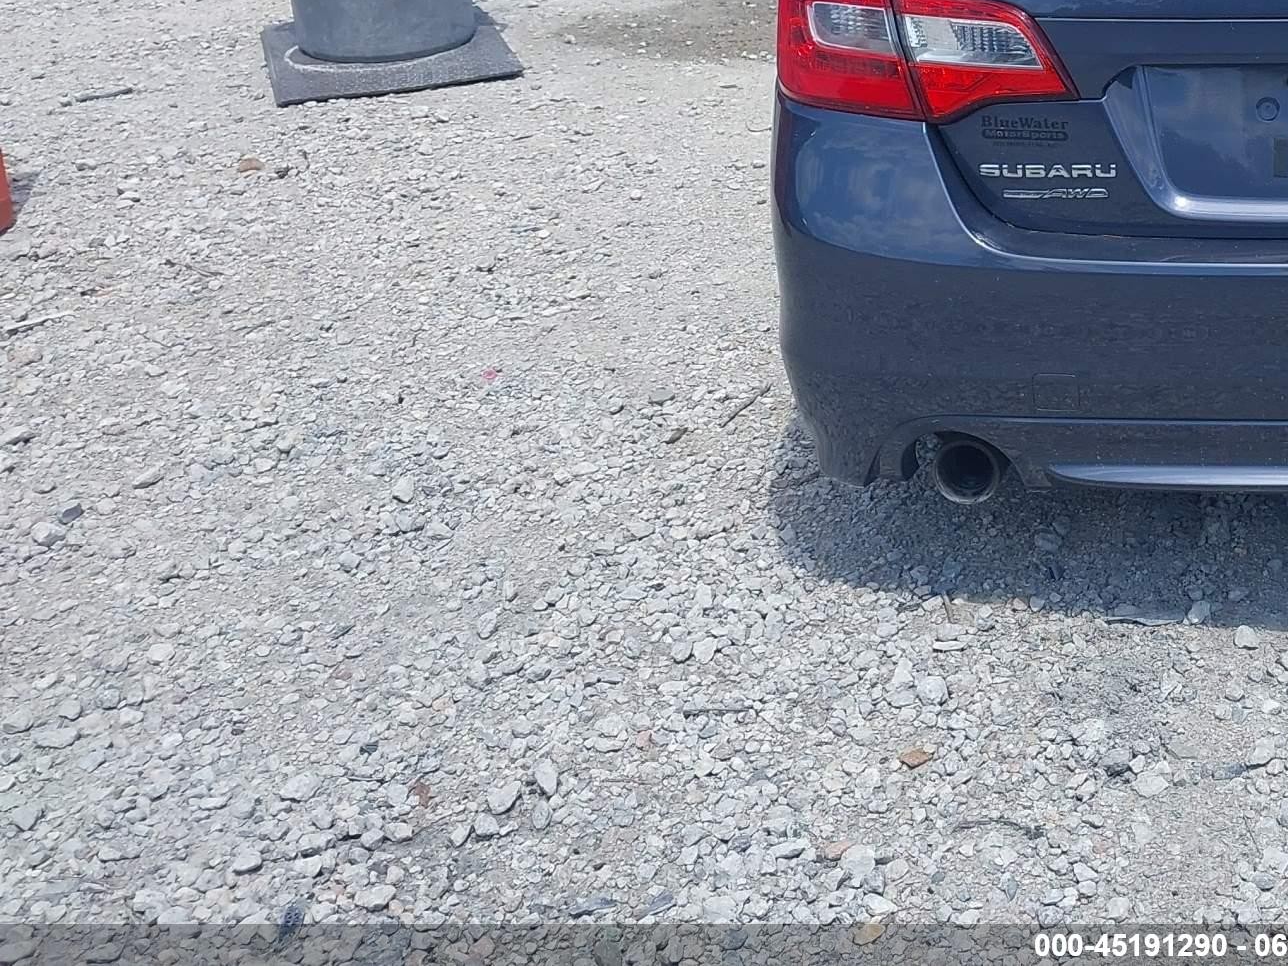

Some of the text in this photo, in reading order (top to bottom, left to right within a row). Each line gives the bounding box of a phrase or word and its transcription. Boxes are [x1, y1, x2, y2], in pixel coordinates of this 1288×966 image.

[981, 115, 1069, 130] BlueWater
[979, 164, 1117, 178] SUBARU
[1044, 188, 1109, 199] AWD
